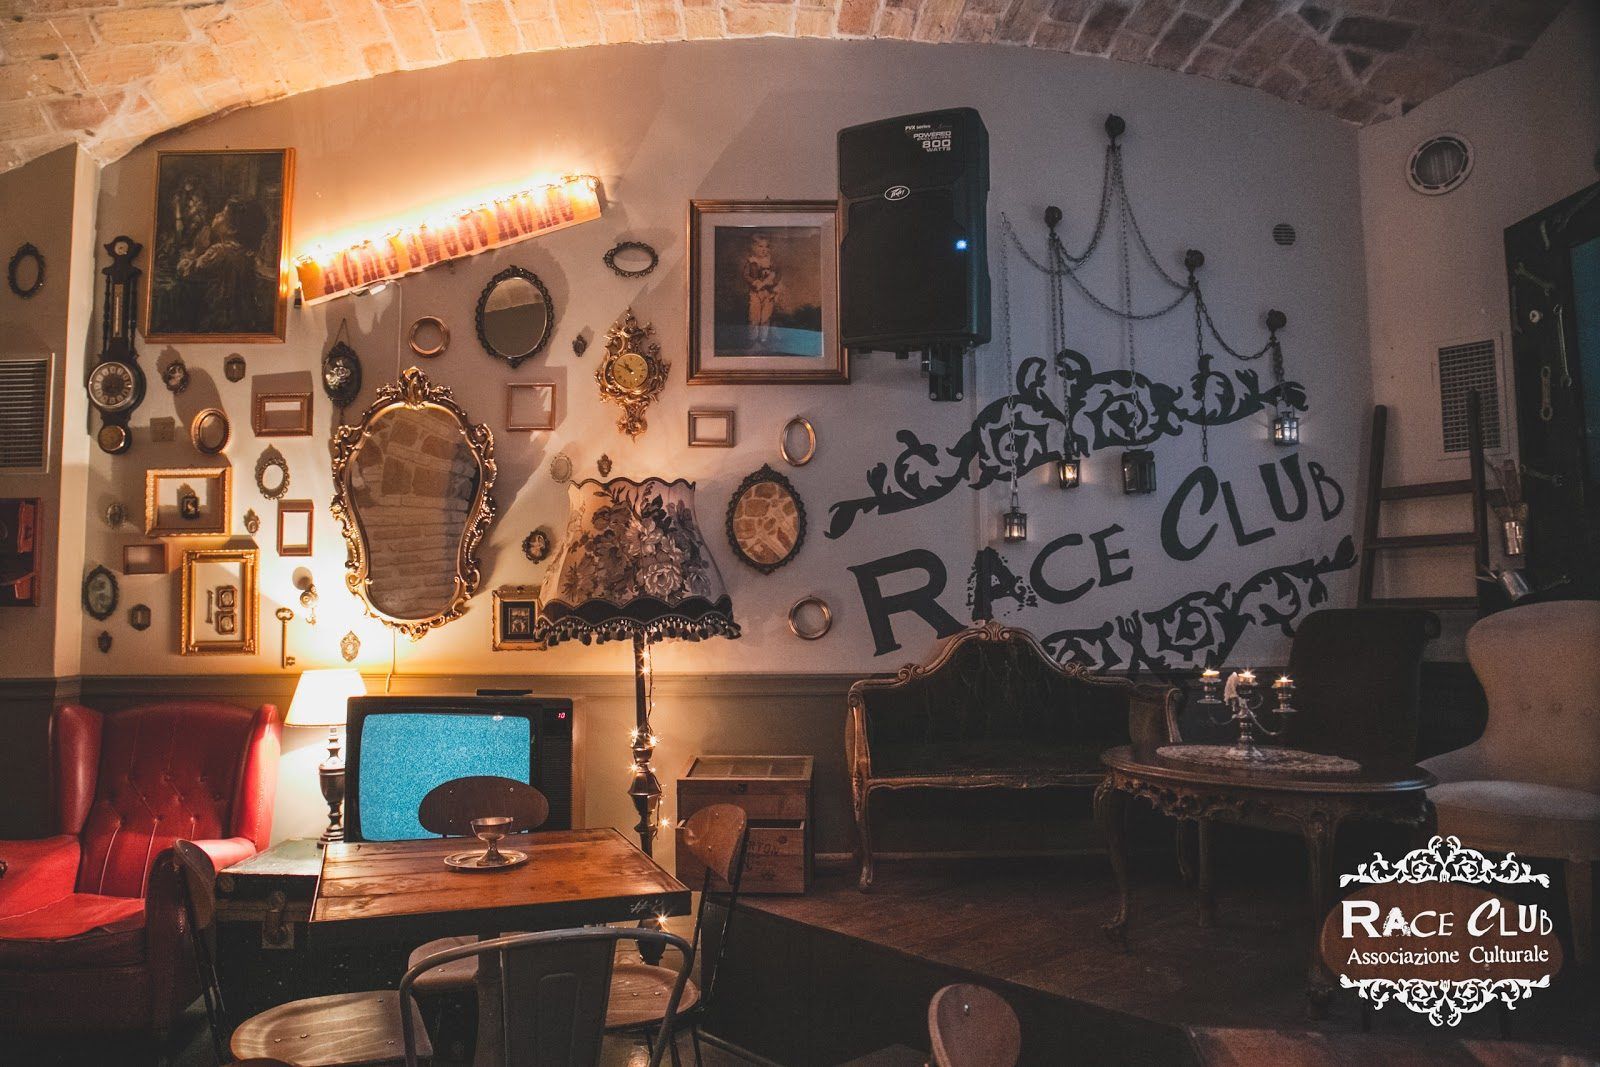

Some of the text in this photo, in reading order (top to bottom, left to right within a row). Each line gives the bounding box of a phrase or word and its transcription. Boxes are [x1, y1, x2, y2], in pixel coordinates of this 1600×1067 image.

[922, 139, 951, 148] 800
[846, 451, 1345, 658] RACE CLUB
